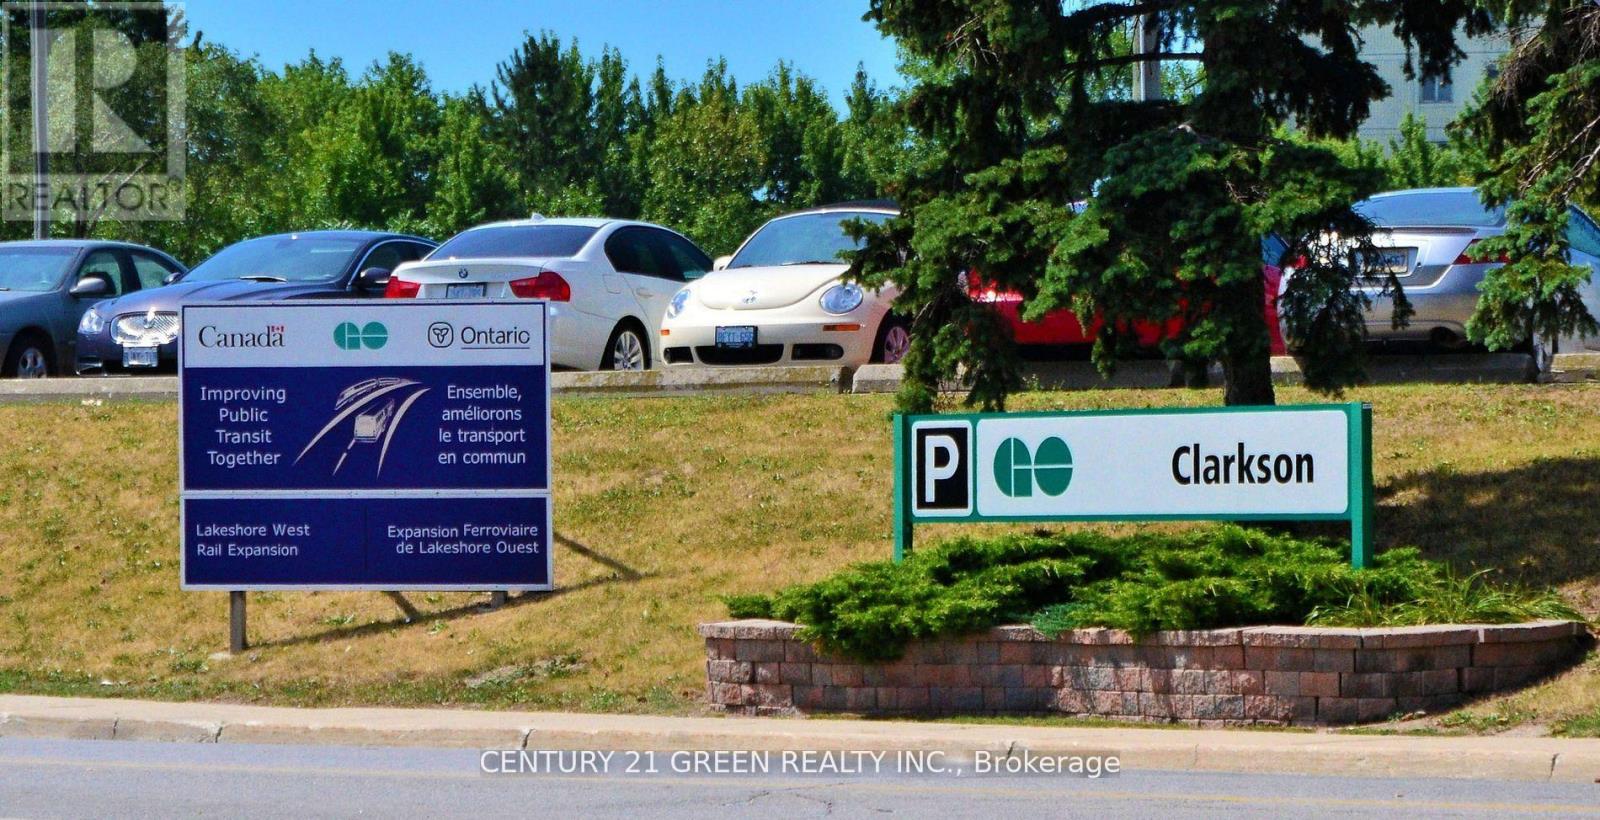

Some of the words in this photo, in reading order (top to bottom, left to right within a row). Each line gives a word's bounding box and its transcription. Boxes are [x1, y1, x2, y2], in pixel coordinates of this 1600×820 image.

[198, 325, 285, 348] Canada
[461, 327, 530, 344] Ontario
[201, 386, 285, 403] Improving
[448, 385, 521, 401] Ensemble,
[220, 408, 267, 422] Public
[442, 405, 521, 420] améliorons
[216, 430, 271, 443] Transit
[439, 428, 451, 442] le
[458, 428, 525, 445] transport
[207, 450, 281, 466] Together
[438, 453, 456, 464] en
[463, 453, 525, 464] commun
[1172, 442, 1313, 485] Clarkson
[925, 435, 959, 502] P
[993, 435, 1075, 499] GO
[197, 524, 266, 536] Lakeshore
[273, 524, 309, 536] West
[388, 526, 458, 540] Expansion
[464, 524, 537, 536] Ferroviaire
[198, 544, 221, 556] Rail
[228, 544, 297, 558] Expansion
[396, 539, 413, 553] de
[420, 541, 490, 553] Lakeshore
[497, 541, 538, 553] Ouest
